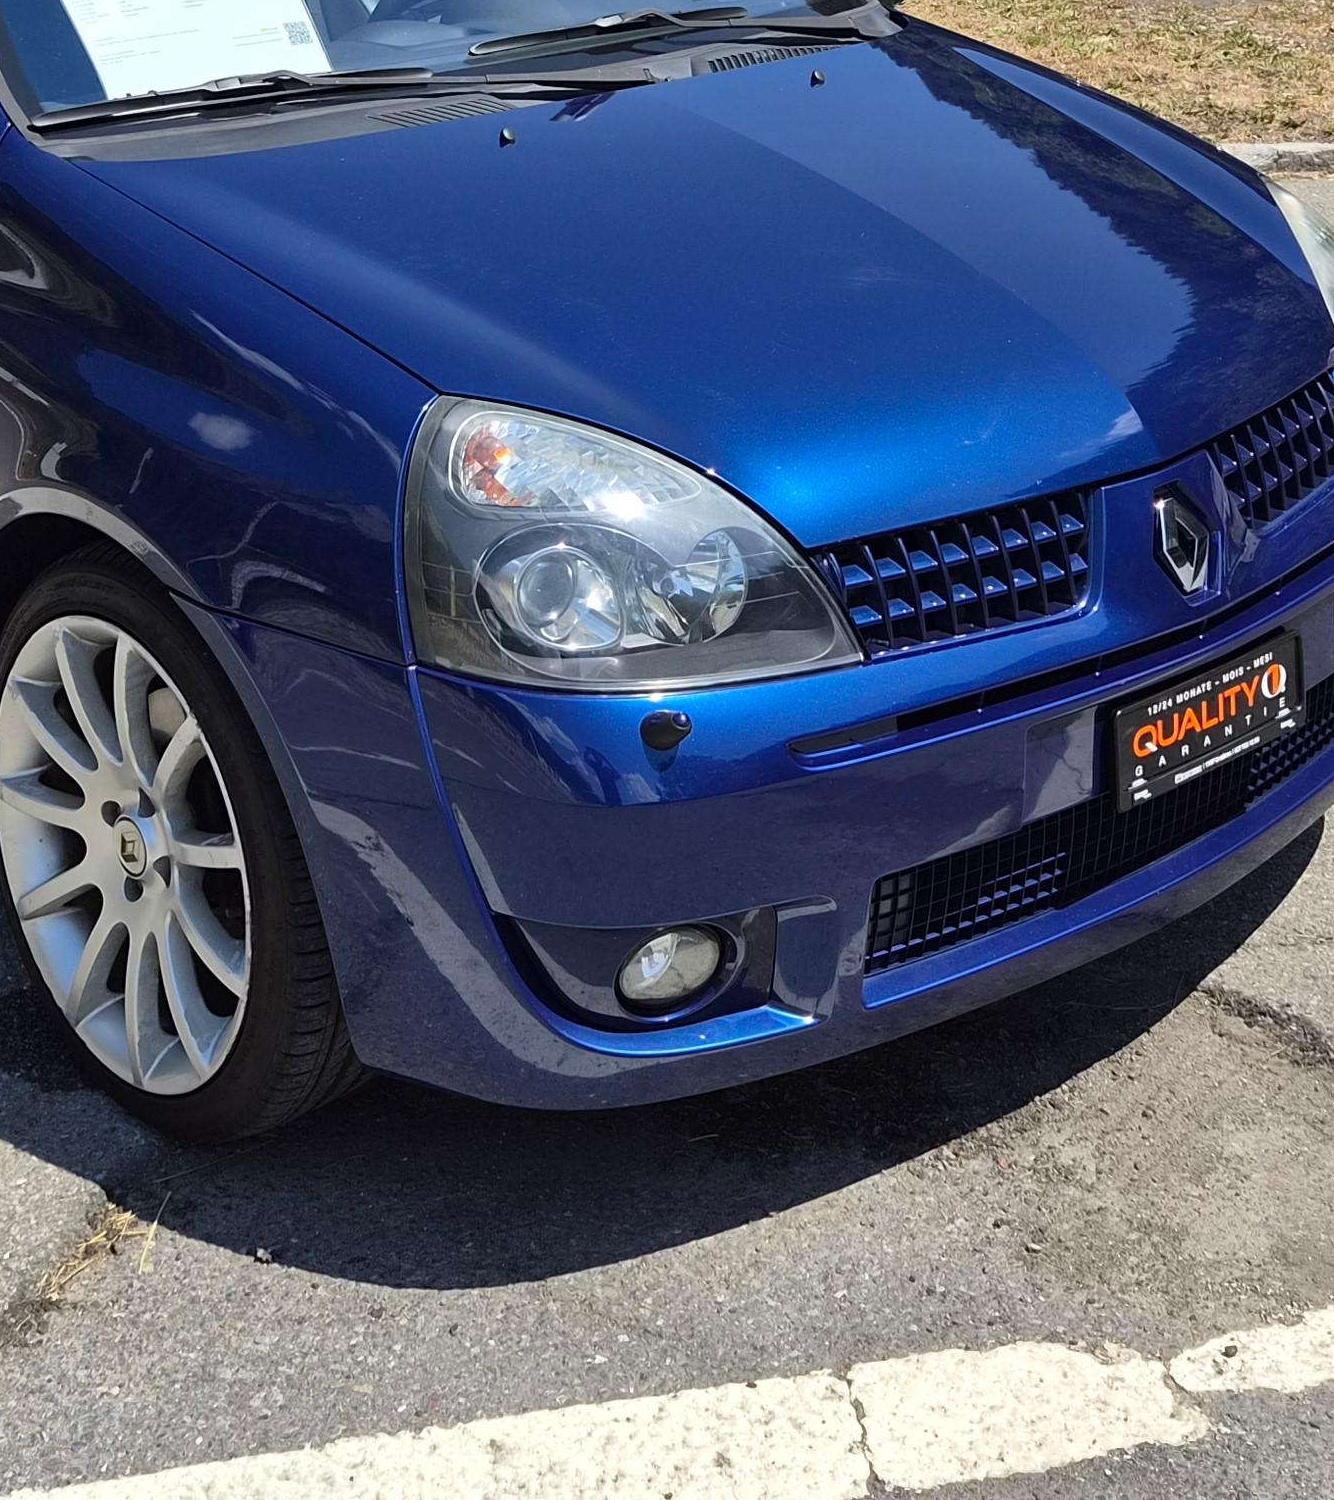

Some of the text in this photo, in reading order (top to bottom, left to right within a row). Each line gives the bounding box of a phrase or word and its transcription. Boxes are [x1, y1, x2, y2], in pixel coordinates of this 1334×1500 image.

[1147, 698, 1173, 716] 12/24
[1176, 680, 1213, 704] MONATE
[1222, 666, 1244, 684] MOIS
[1253, 651, 1273, 669] MESI
[1135, 697, 1286, 777] GARANTIE
